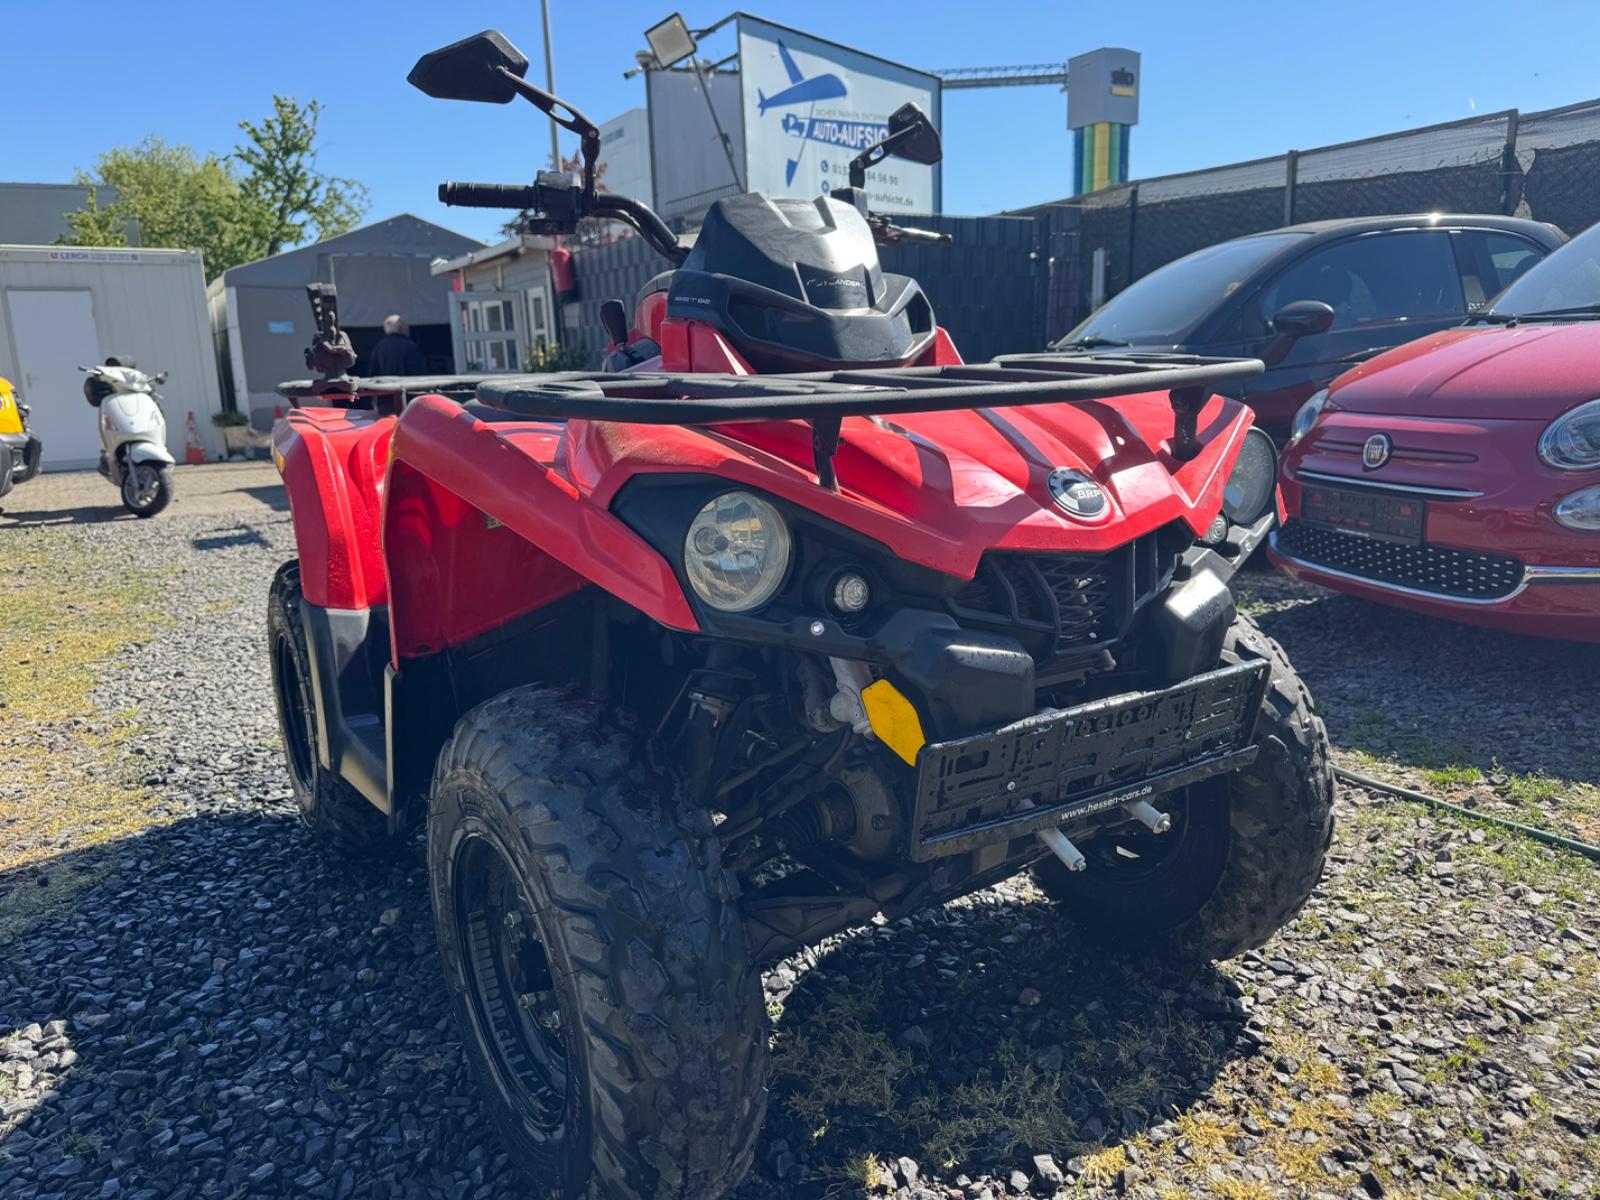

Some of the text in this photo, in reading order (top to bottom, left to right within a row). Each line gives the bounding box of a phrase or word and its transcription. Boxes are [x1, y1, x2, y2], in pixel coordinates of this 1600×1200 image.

[813, 121, 889, 148] AUTO-AUFSIC
[60, 252, 89, 260] LERCH
[1077, 489, 1101, 498] BRP
[1061, 785, 1153, 820] www.hessen-cars.de
